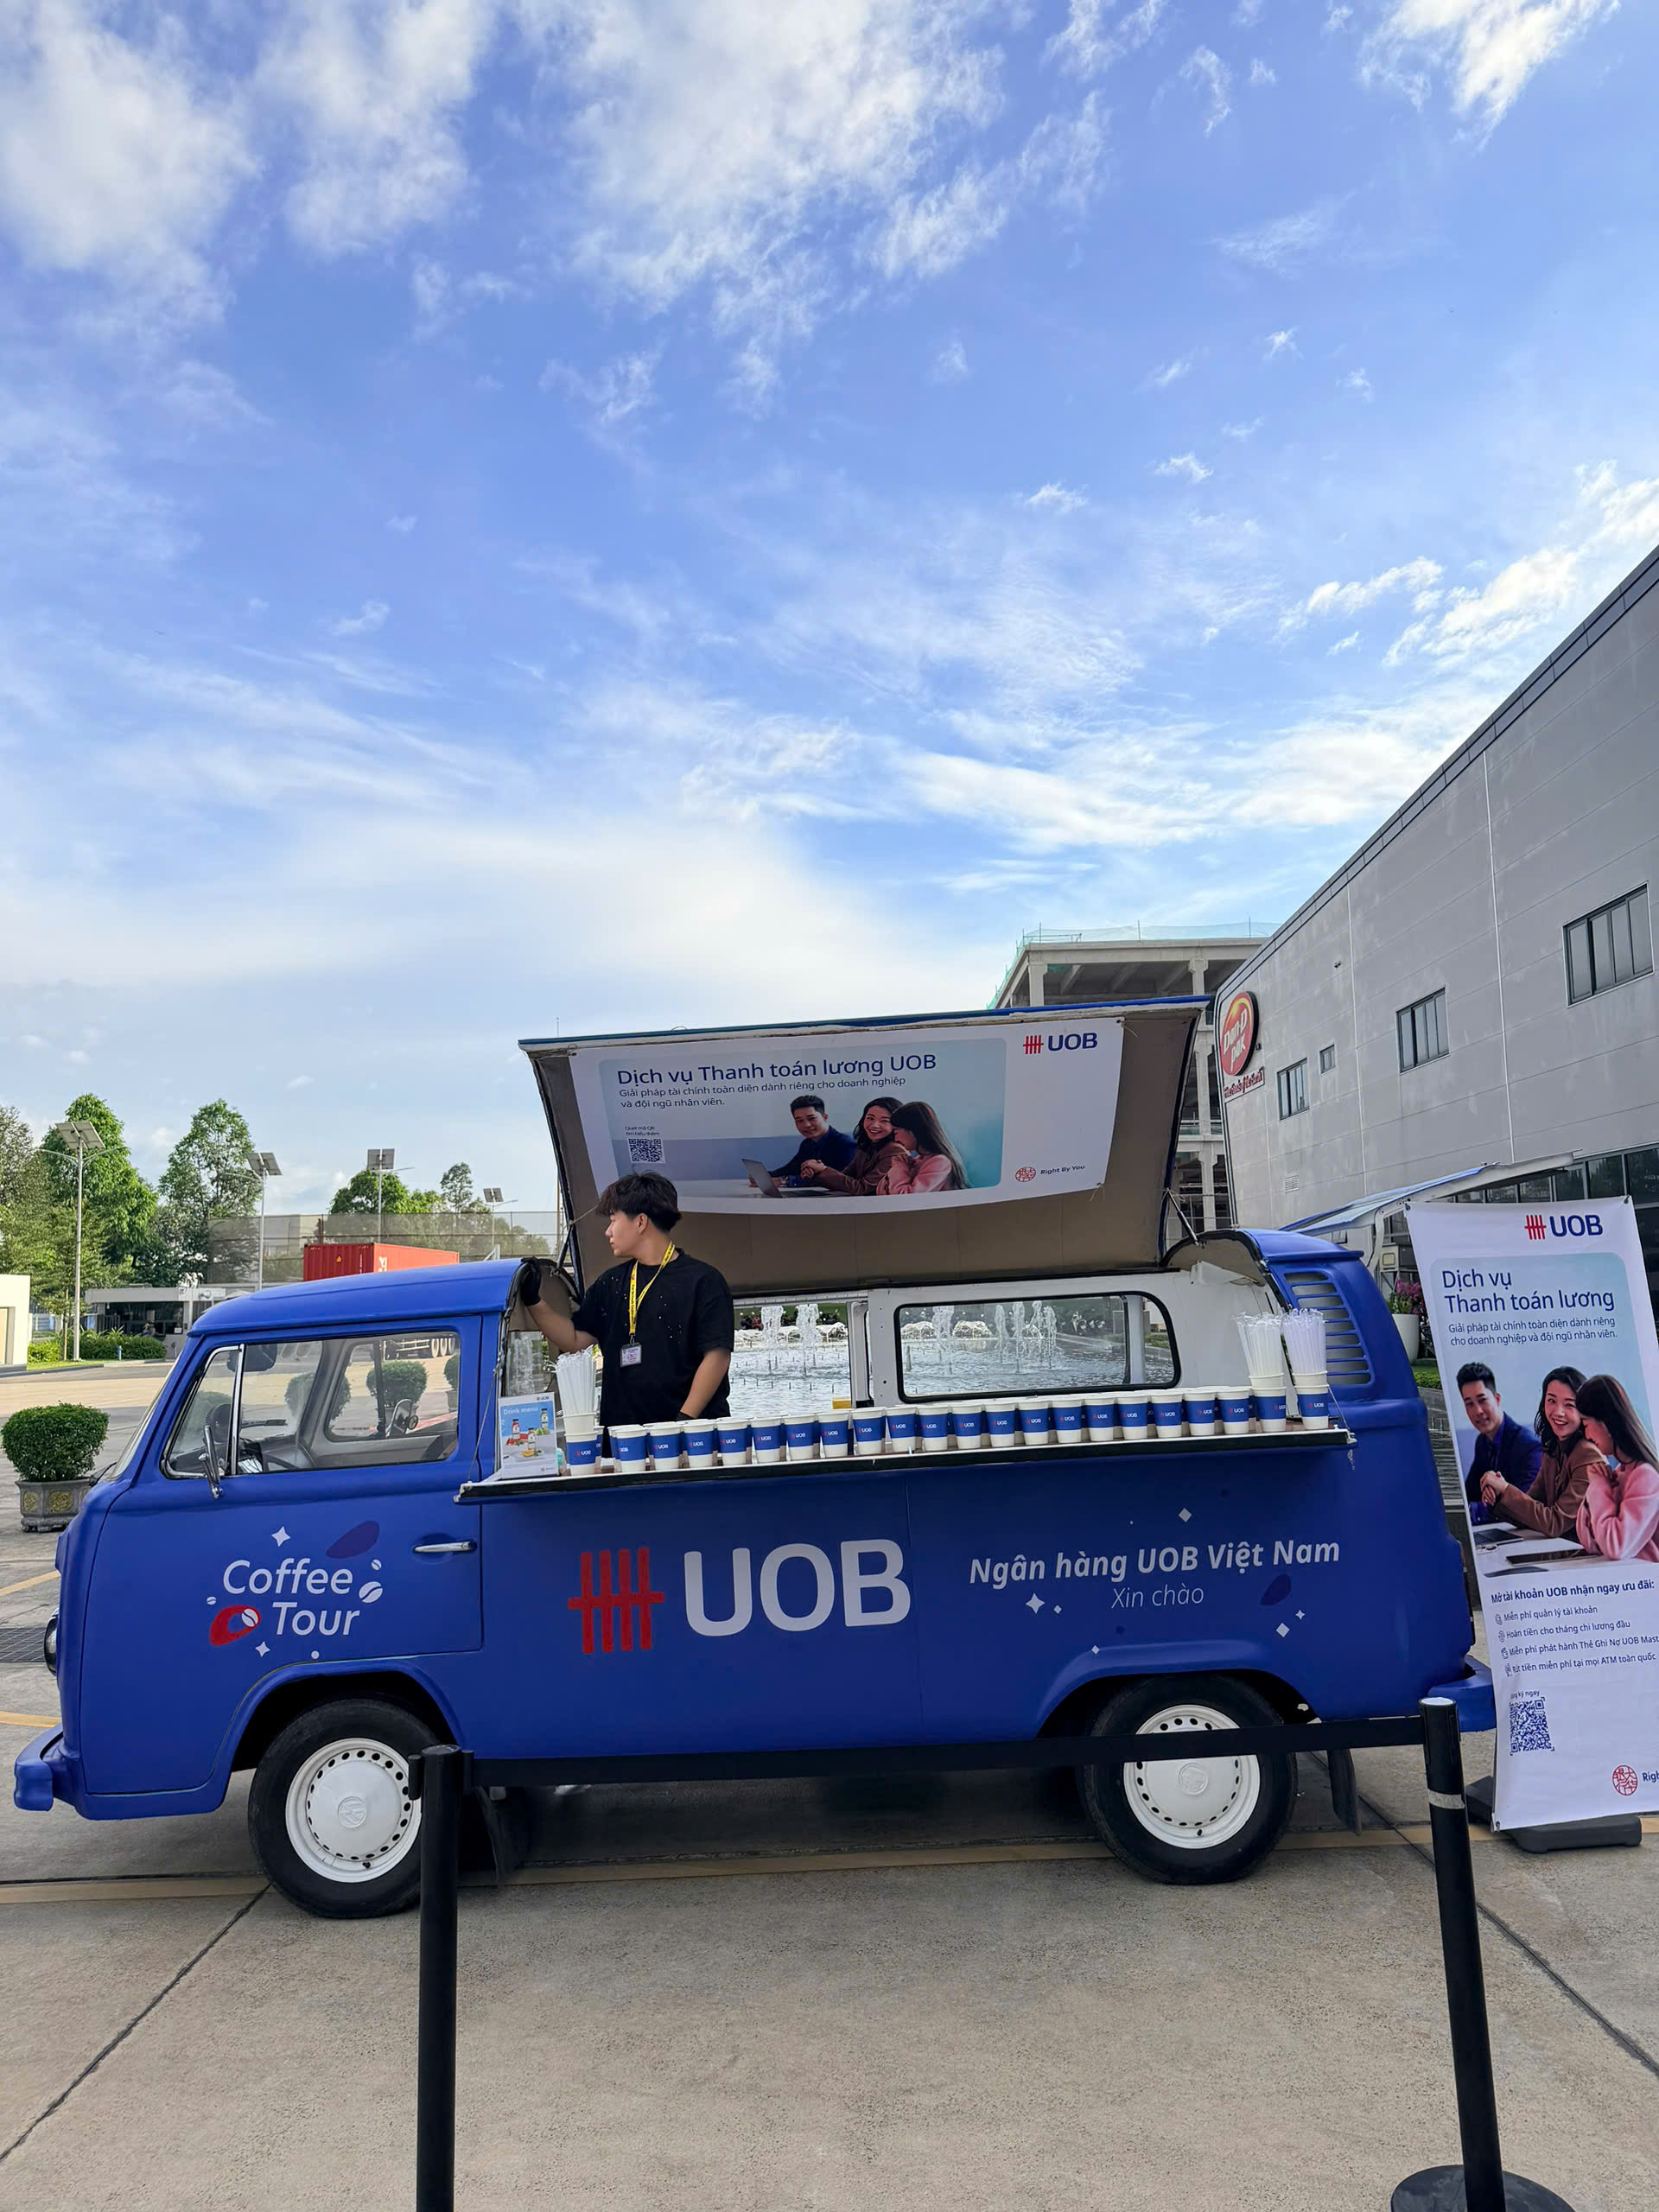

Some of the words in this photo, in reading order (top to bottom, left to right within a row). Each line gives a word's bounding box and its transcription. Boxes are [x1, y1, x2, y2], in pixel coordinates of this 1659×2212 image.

[1048, 1033, 1098, 1052] UOB
[617, 1068, 662, 1087] Dịch
[668, 1071, 692, 1084] vụ
[698, 1063, 764, 1080] Thanh
[771, 1060, 817, 1077] toán
[823, 1059, 883, 1077] lương
[890, 1054, 937, 1071] UOB
[620, 1087, 639, 1097] Giải
[640, 1086, 665, 1098] pháp
[668, 1085, 681, 1096] tài
[683, 1084, 710, 1095] chính
[712, 1084, 734, 1094] toàn
[737, 1083, 759, 1094] diện
[761, 1081, 786, 1091] dành
[789, 1080, 815, 1092] riêng
[817, 1079, 836, 1090] cho
[837, 1077, 868, 1088] doanh
[872, 1077, 906, 1086] nghiệp
[635, 1098, 651, 1109] đội
[652, 1098, 671, 1109] ngũ
[675, 1097, 700, 1107] nhân
[702, 1096, 725, 1106] viên.
[1549, 1215, 1604, 1236] UOB
[1442, 1268, 1484, 1292] Dịch
[1488, 1272, 1512, 1290] vụ
[1445, 1293, 1506, 1313] Thanh
[1510, 1291, 1554, 1311] toán
[1559, 1289, 1615, 1312] lương
[1449, 1322, 1465, 1333] Giải
[1466, 1321, 1489, 1334] pháp
[1491, 1321, 1502, 1332] tài
[1503, 1319, 1527, 1331] chính
[1528, 1319, 1548, 1330] toàn
[1550, 1318, 1568, 1330] diện
[1570, 1317, 1592, 1327] dành
[1593, 1317, 1616, 1329] riêng
[1451, 1336, 1466, 1346] cho
[1468, 1334, 1495, 1345] doanh
[1497, 1332, 1527, 1346] nghiệp
[1529, 1333, 1539, 1342] và
[1541, 1332, 1554, 1343] đội
[1555, 1332, 1573, 1344] ngũ
[1574, 1330, 1597, 1339] nhân
[1598, 1329, 1618, 1339] viên.
[969, 1554, 1046, 1590] Ngân
[1055, 1550, 1128, 1583] hàng
[1137, 1546, 1198, 1573] UOB
[1208, 1541, 1263, 1574] Việt
[1273, 1540, 1339, 1566] Nam
[223, 1558, 353, 1595] Coffee
[683, 1538, 911, 1637] UOB
[1111, 1586, 1144, 1609] Xin
[1152, 1583, 1205, 1605] chào
[1491, 1592, 1503, 1604] Mở
[1503, 1591, 1512, 1602] tài
[1515, 1587, 1544, 1600] khoản
[1546, 1586, 1568, 1598] UOB
[1570, 1585, 1594, 1597] nhận
[1597, 1582, 1620, 1595] ngay
[1622, 1581, 1636, 1592] ưu
[1637, 1580, 1655, 1590] đãi:
[272, 1601, 360, 1636] Tour
[1520, 1610, 1532, 1622] phí
[1533, 1609, 1552, 1619] quản
[1554, 1608, 1561, 1618] lý
[1563, 1606, 1573, 1616] tài
[1574, 1605, 1598, 1615] khoản
[1523, 1627, 1538, 1637] tiền
[1540, 1626, 1554, 1635] cho
[1555, 1624, 1579, 1634] tháng
[1580, 1623, 1591, 1631] chi
[1592, 1622, 1614, 1631] lương
[1616, 1620, 1630, 1629] đầu
[1525, 1644, 1537, 1656] phí
[1539, 1643, 1557, 1655] phát
[1558, 1641, 1579, 1651] hành
[1595, 1638, 1607, 1648] Ghi
[1609, 1638, 1621, 1648] Nợ
[1622, 1636, 1640, 1645] UOB
[1522, 1662, 1537, 1671] tiền
[1560, 1658, 1573, 1670] phí
[1573, 1657, 1584, 1668] tại
[1601, 1655, 1618, 1665] ATM
[1618, 1654, 1637, 1663] toàn
